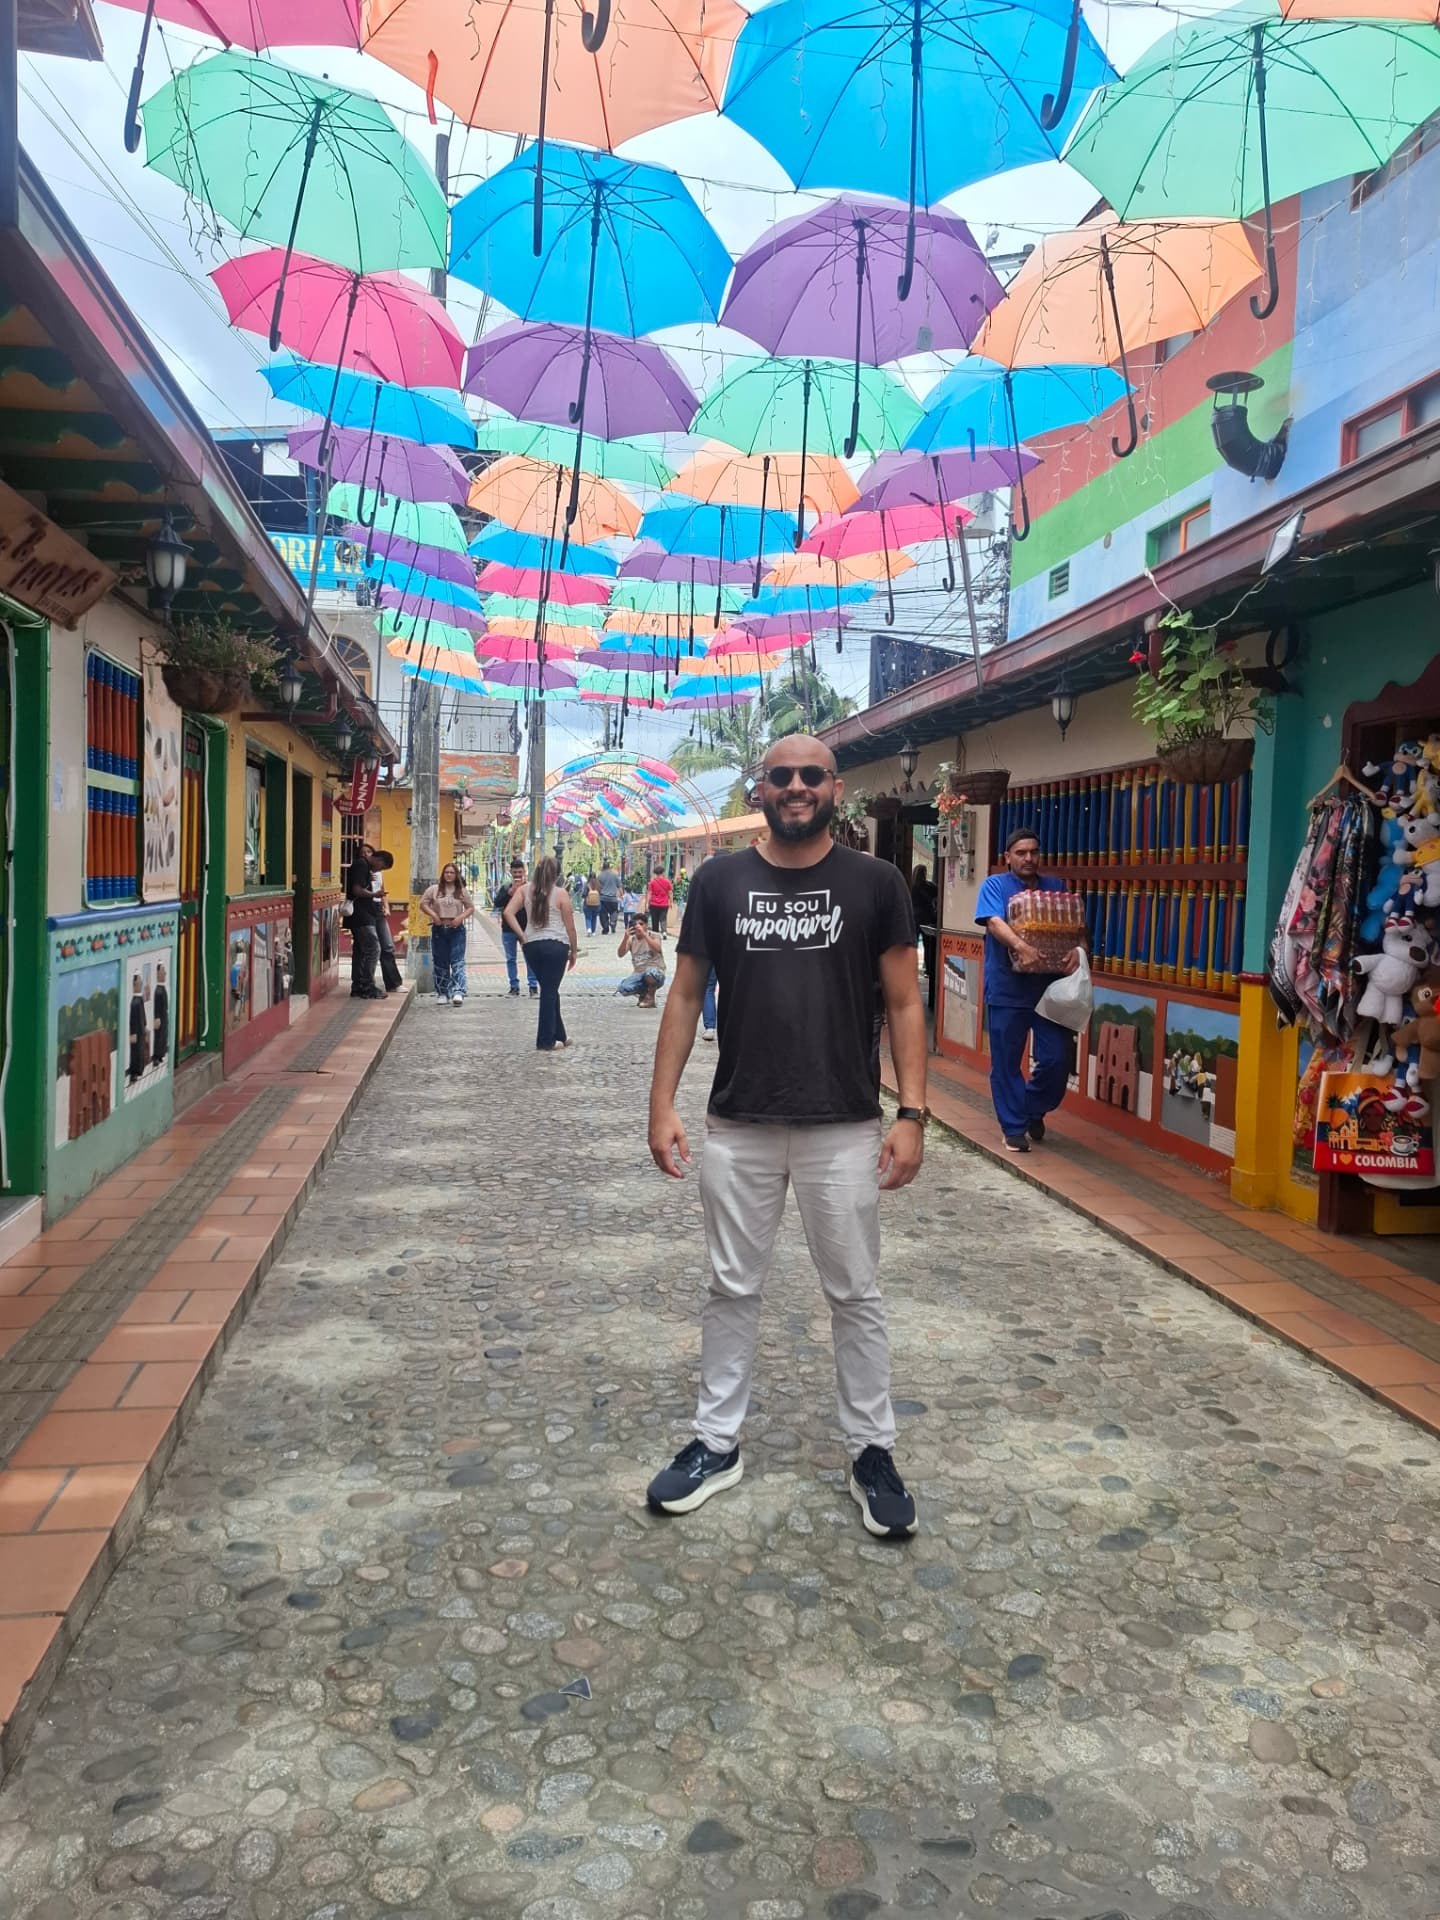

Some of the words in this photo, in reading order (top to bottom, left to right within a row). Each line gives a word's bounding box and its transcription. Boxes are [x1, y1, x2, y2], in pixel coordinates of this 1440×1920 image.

[756, 900, 777, 913] EU
[784, 899, 819, 914] SOU
[735, 904, 844, 944] imparável
[1332, 1153, 1337, 1165] I
[1354, 1154, 1419, 1169] COLOMBIA
